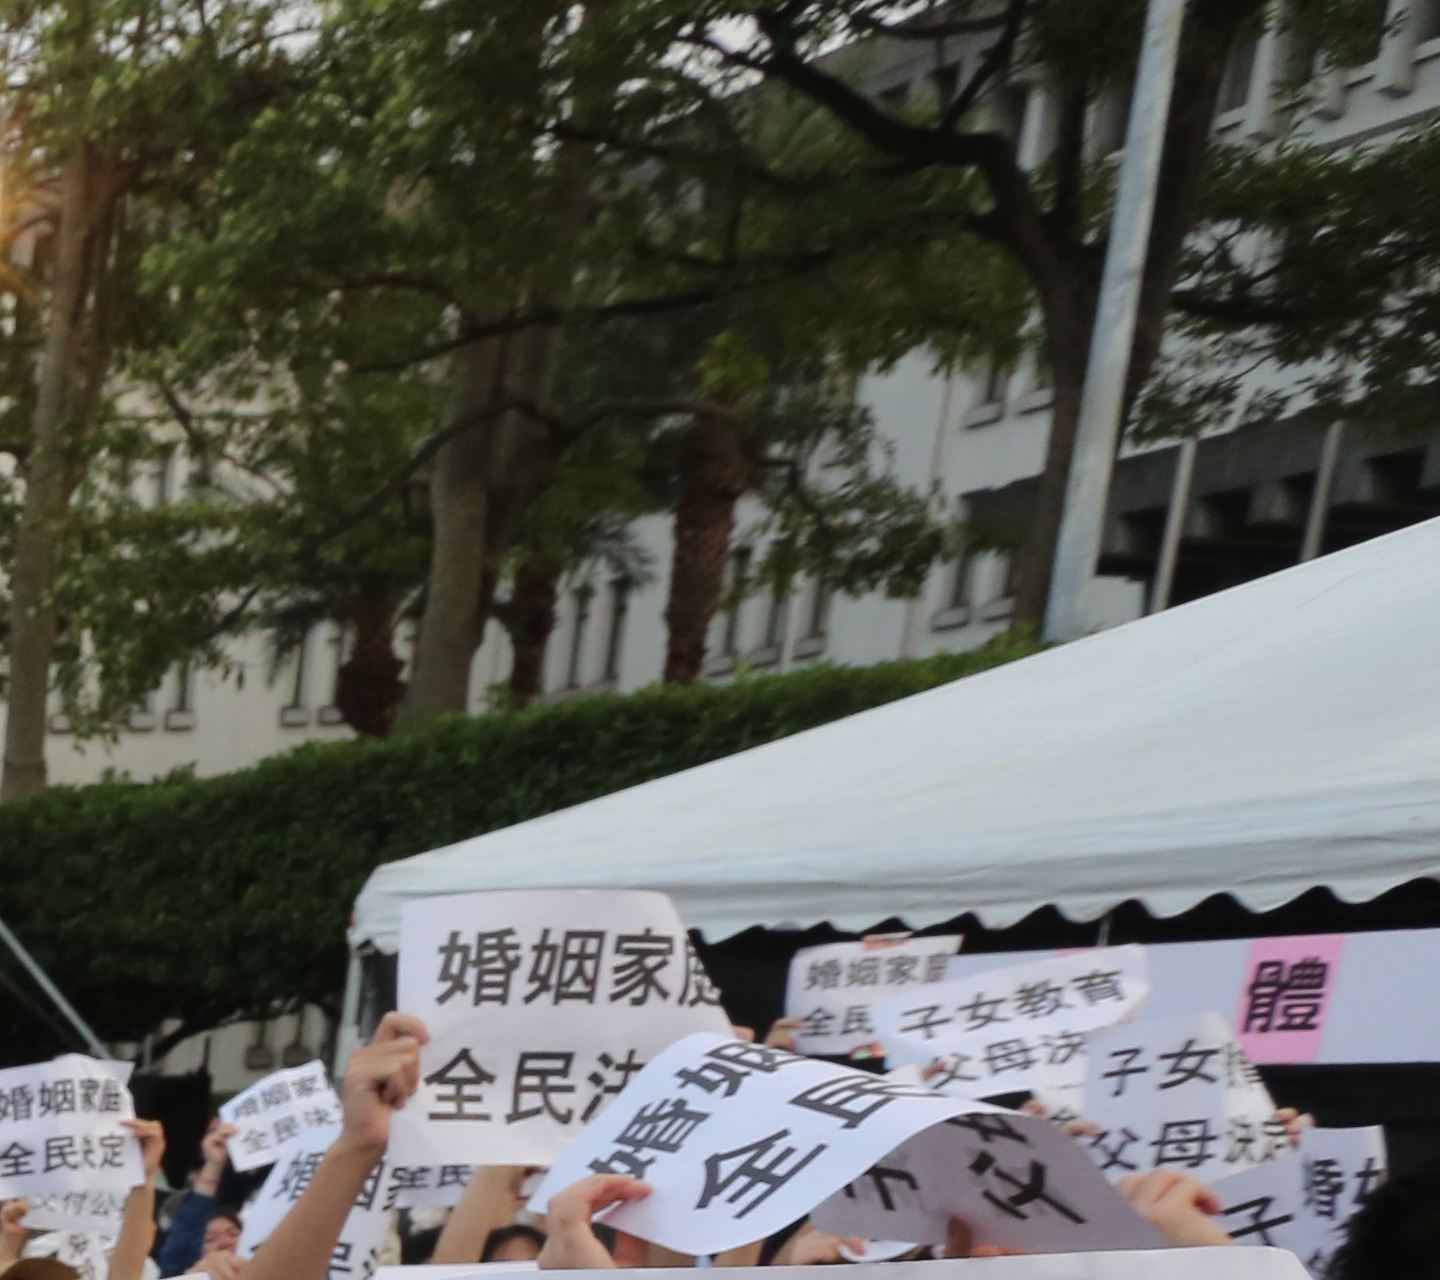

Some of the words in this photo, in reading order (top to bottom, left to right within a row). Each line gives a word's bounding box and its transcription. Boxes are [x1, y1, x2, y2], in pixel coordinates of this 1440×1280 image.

[899, 969, 1124, 1041] 子女教育
[1242, 957, 1330, 1034] 體
[242, 1103, 345, 1153] 全民決
